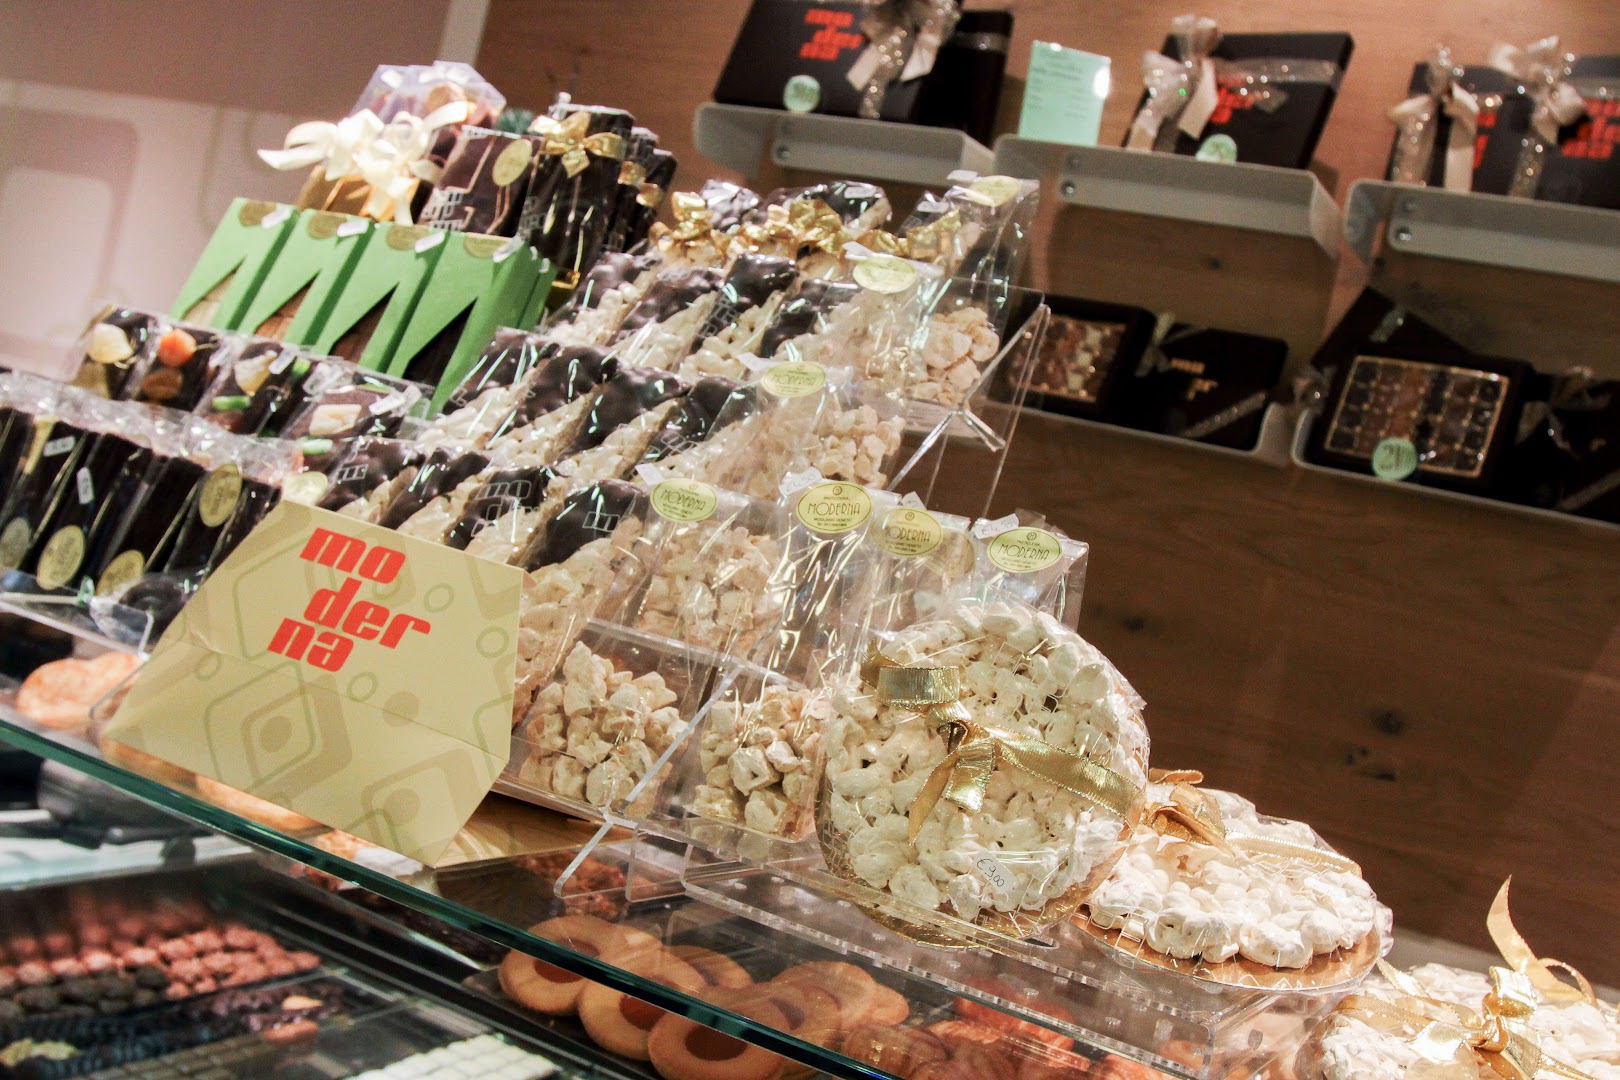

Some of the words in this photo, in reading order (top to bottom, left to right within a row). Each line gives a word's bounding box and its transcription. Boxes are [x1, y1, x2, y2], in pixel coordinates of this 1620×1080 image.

[661, 489, 707, 511] MODERNA
[807, 502, 860, 516] MODERNA
[300, 527, 406, 584] mo
[997, 543, 1050, 561] MODERNA
[303, 577, 431, 649] der
[267, 617, 354, 673] na
